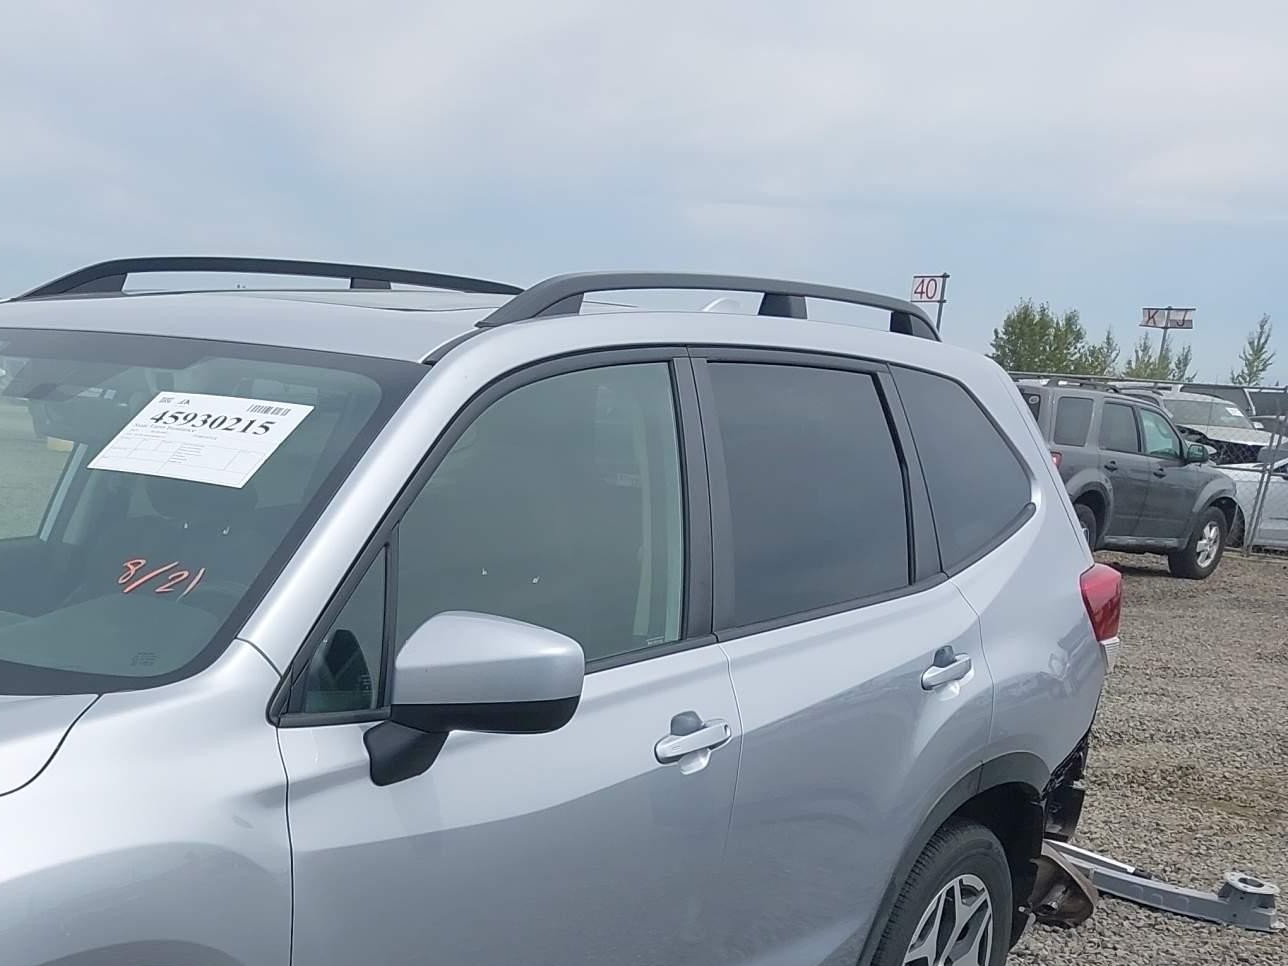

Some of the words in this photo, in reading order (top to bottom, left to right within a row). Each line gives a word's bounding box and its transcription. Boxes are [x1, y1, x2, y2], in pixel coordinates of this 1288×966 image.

[914, 278, 938, 300] 40
[1146, 310, 1159, 325] K
[1176, 310, 1188, 327] J
[150, 410, 276, 435] 45930215
[118, 559, 206, 602] 8/21
